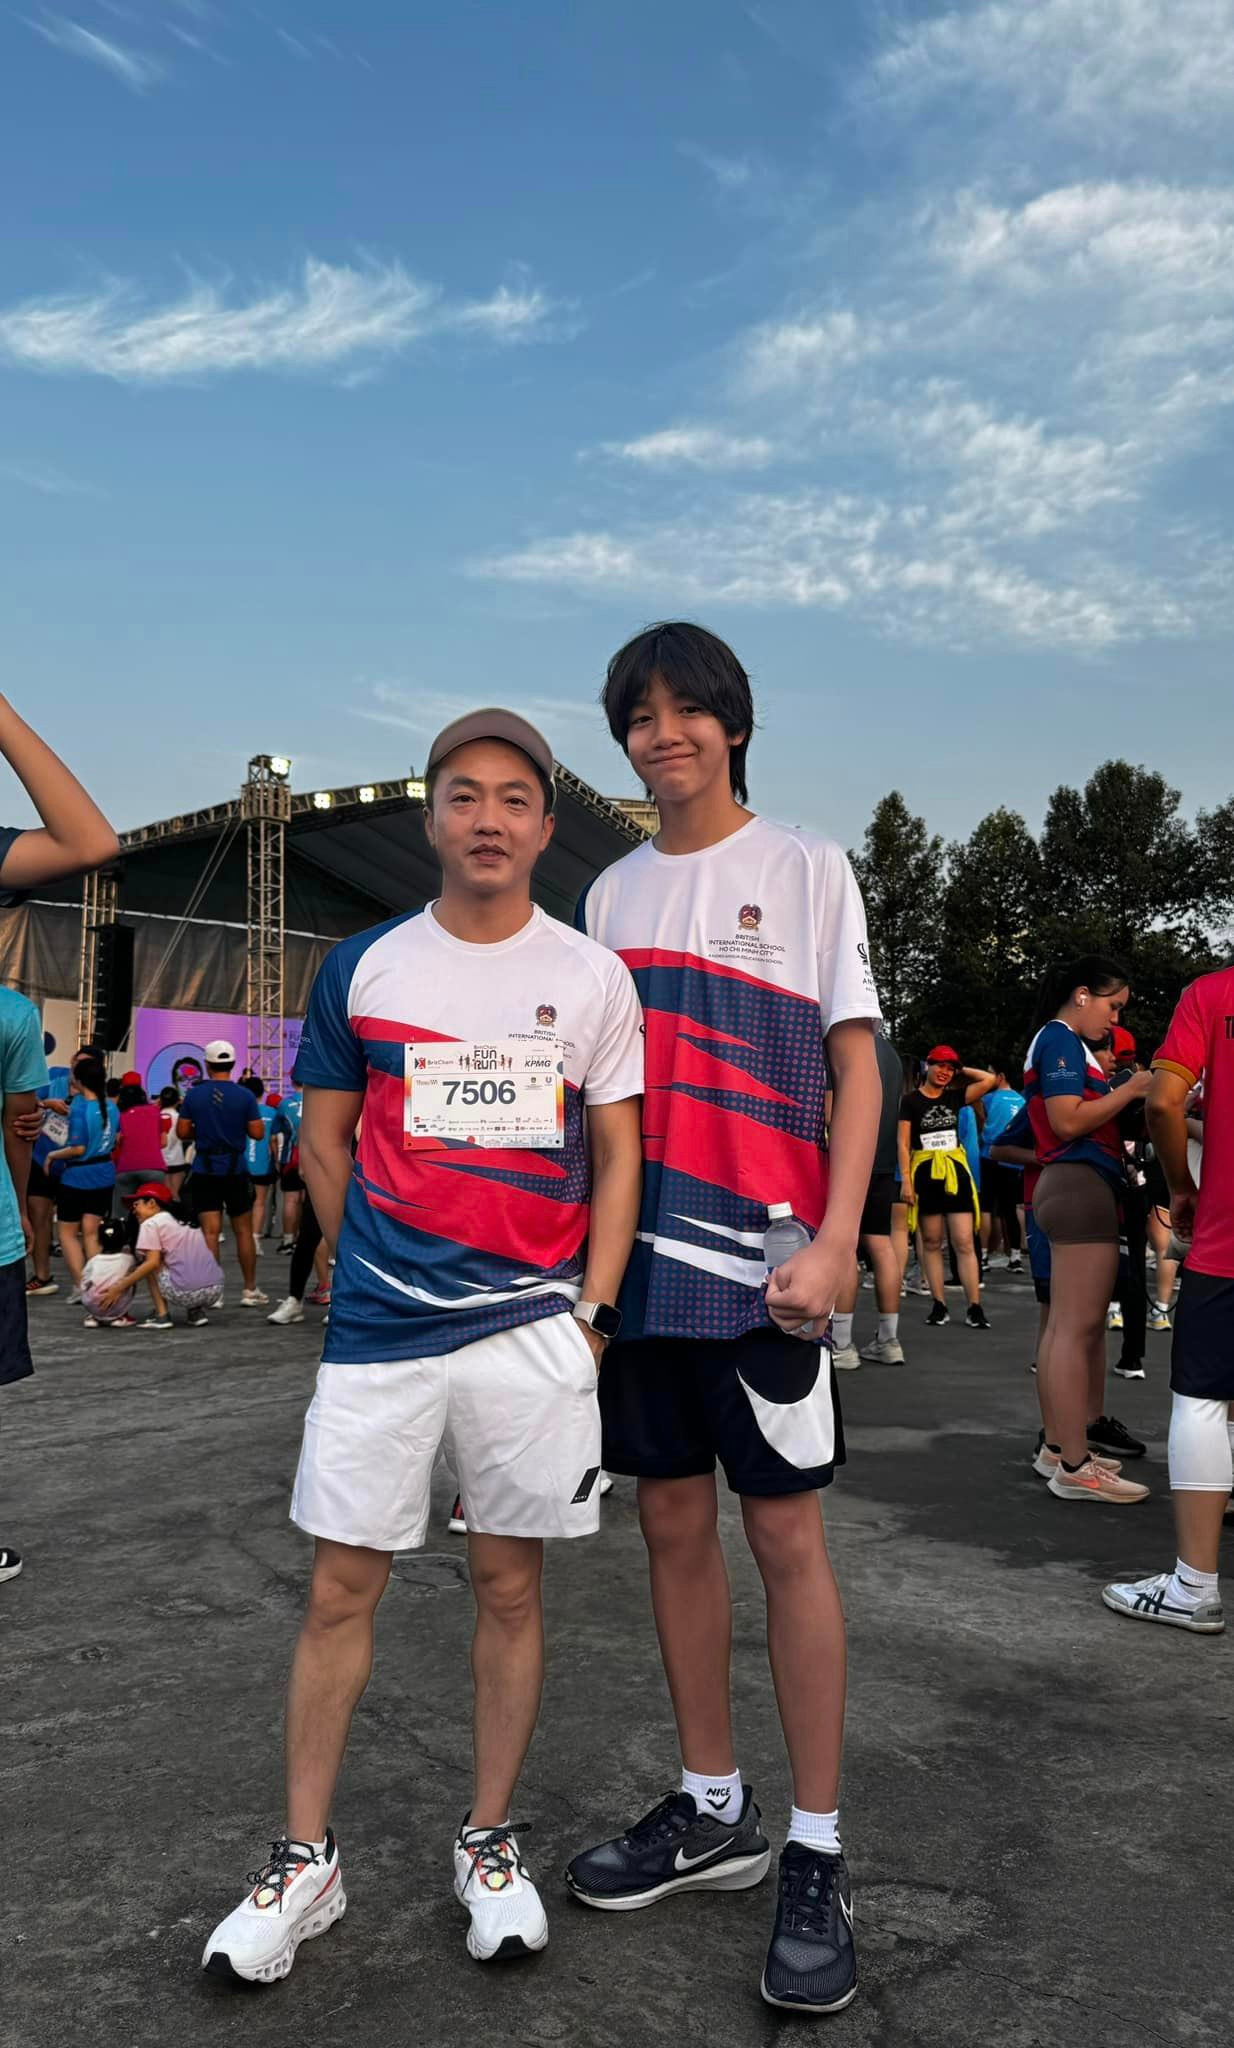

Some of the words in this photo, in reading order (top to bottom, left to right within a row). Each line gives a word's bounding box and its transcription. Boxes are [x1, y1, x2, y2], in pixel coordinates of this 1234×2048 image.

[735, 934, 759, 942] BRITISH
[708, 940, 758, 948] INTERNATIONAL
[759, 944, 786, 952] SCHOOL
[533, 1029, 556, 1037] BRITISH
[473, 1050, 497, 1059] FUN
[473, 1059, 497, 1070] RUN
[524, 1060, 551, 1068] KPMG
[442, 1079, 516, 1105] 7506
[706, 1786, 731, 1797] NICE
